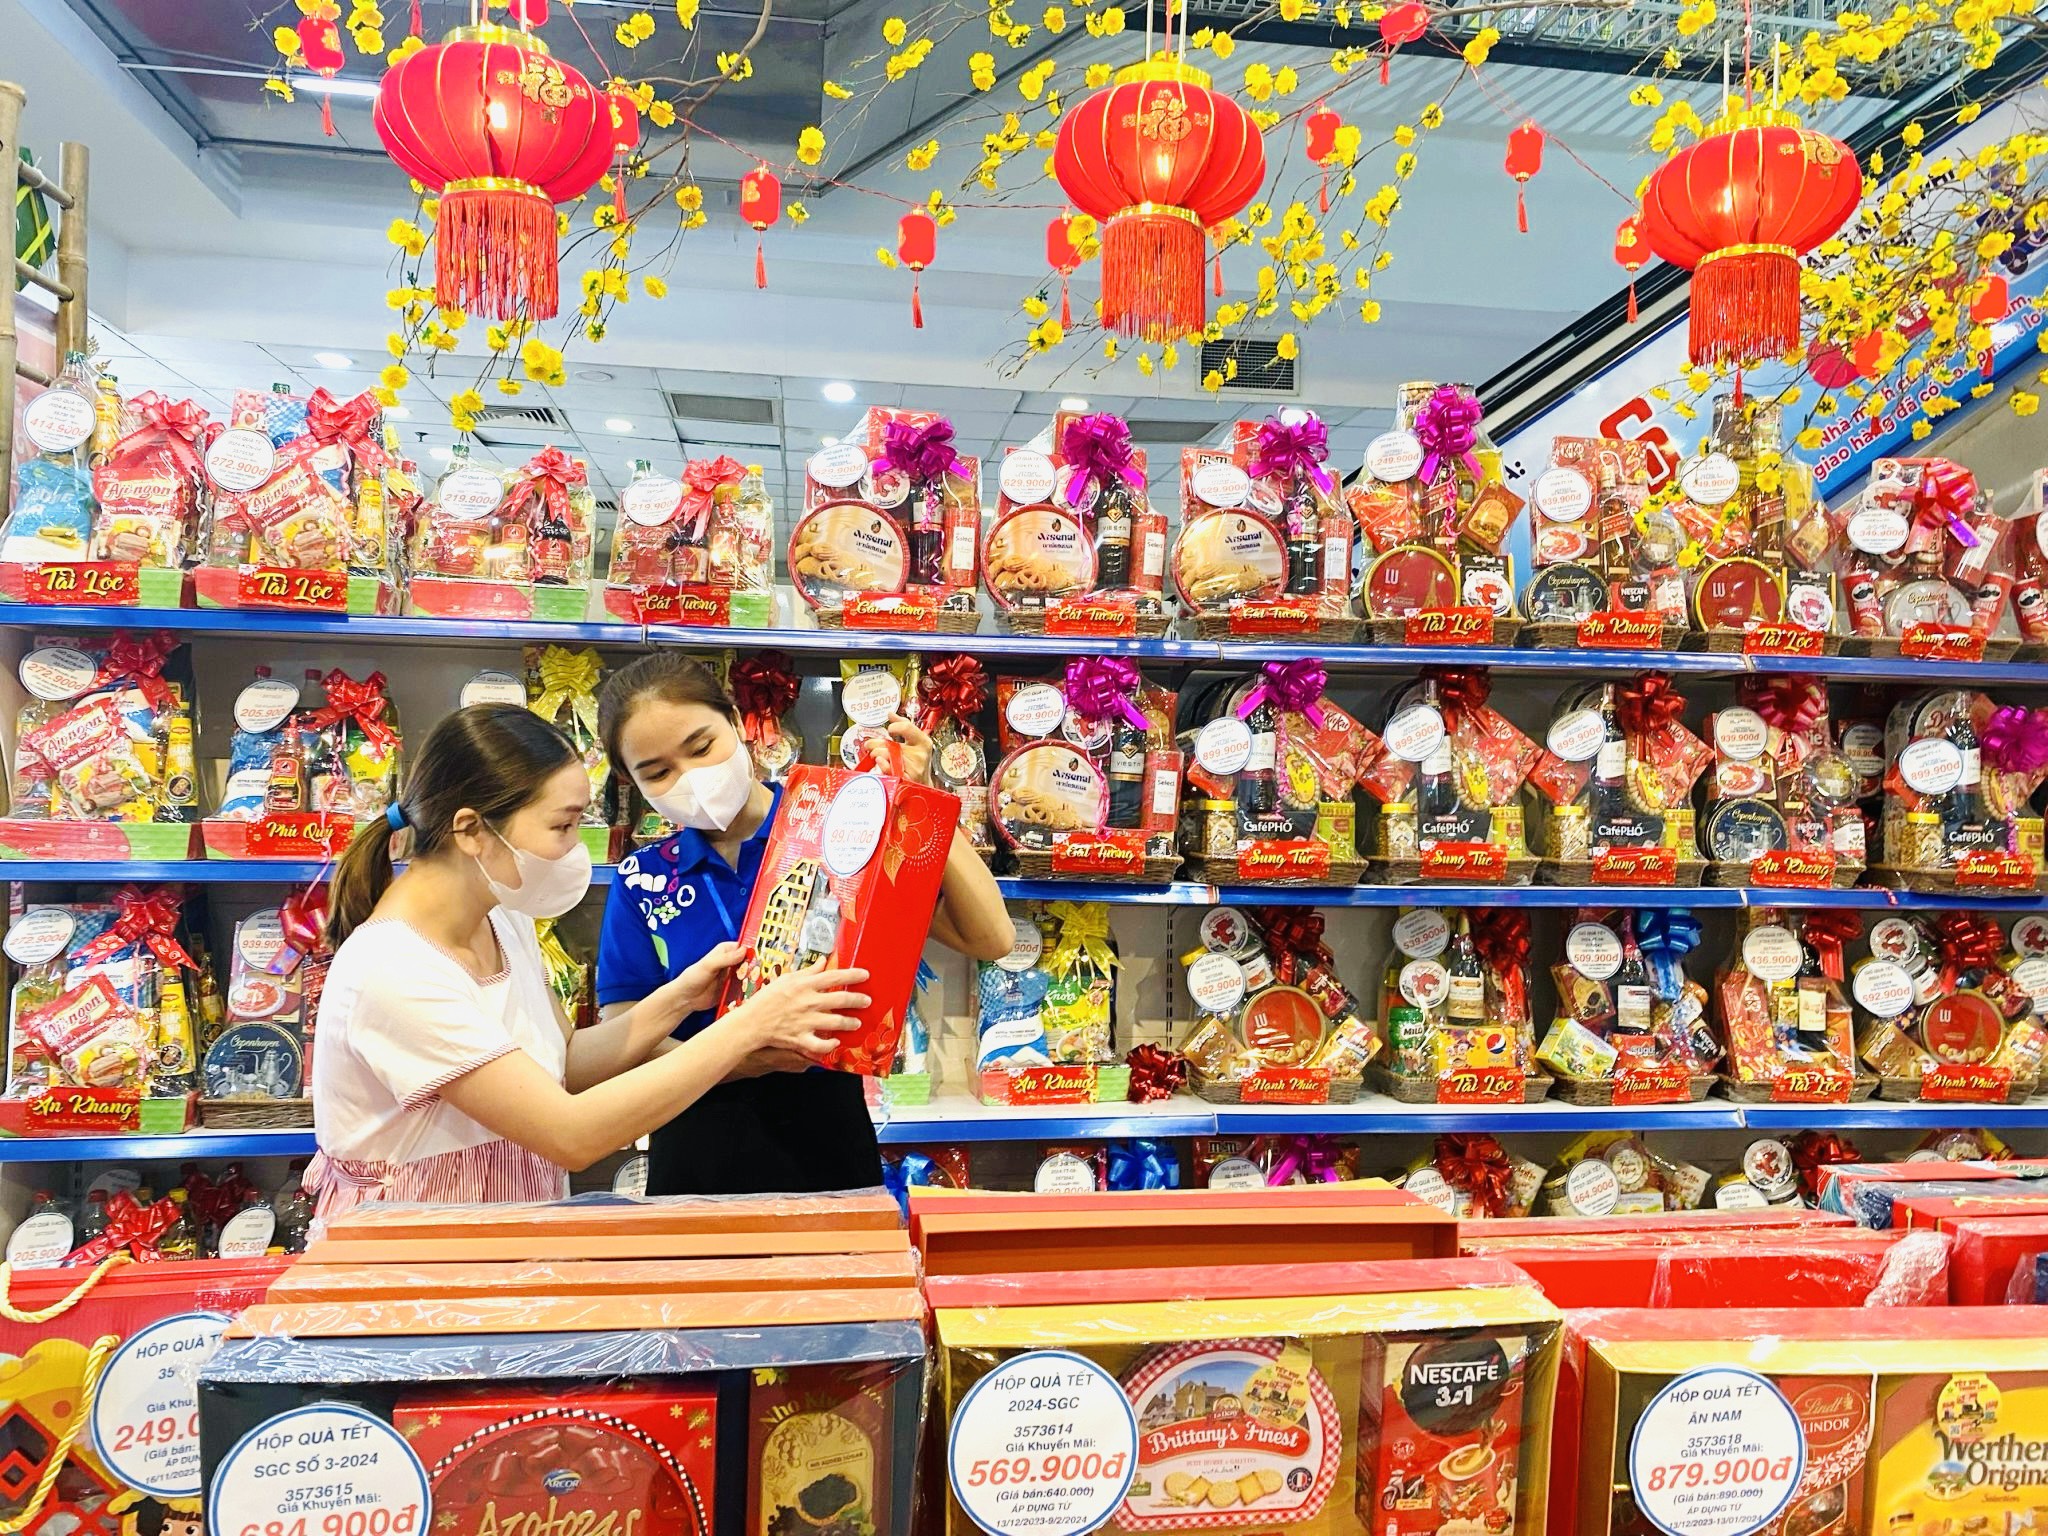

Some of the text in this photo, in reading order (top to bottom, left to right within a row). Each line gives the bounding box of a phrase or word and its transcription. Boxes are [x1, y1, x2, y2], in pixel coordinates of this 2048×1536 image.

[1814, 448, 1849, 481] giao
[1896, 397, 1918, 420] đã
[1919, 381, 1940, 402] có
[211, 456, 268, 477] 272.900đ
[1004, 478, 1051, 488] 629.900đ
[1200, 484, 1246, 494] 629.900đ
[445, 494, 499, 504] 219.900đ
[1542, 494, 1582, 506] 939.900đ
[853, 529, 893, 548] Arsenal
[1037, 532, 1076, 542] Arsenal
[1224, 531, 1263, 545] Arsenal
[39, 567, 77, 592] Tài
[253, 571, 290, 597] Tài
[1385, 569, 1399, 584] LU
[1712, 583, 1726, 598] LU
[646, 593, 719, 616] Cát Tường
[1058, 605, 1081, 621] Cát
[1420, 612, 1446, 632] Tài
[1583, 618, 1657, 640] An Khang
[27, 663, 86, 690] 272.900đ
[850, 693, 898, 713] 539.900đ
[1012, 708, 1061, 721] 629.900đ
[1394, 723, 1440, 751] 899.900đ
[1556, 724, 1603, 751] 899.900đ
[1720, 734, 1760, 742] 939.900đ
[1203, 740, 1249, 760] 899.900đ
[1052, 769, 1091, 784] Arsenal
[1910, 760, 1960, 781] 899.900đ
[1731, 809, 1773, 823] Copenhagen
[266, 821, 335, 843] Phú Quý
[1249, 847, 1315, 868] Sung Túc
[1432, 849, 1493, 870] Sung Túc
[1602, 854, 1664, 875] Sung Túc
[1757, 856, 1831, 880] An Khang
[1967, 858, 1999, 876] Sung
[9, 932, 67, 946] 272.900đ
[241, 939, 283, 949] 939.900
[1403, 926, 1446, 950] 539.900đ
[1574, 953, 1619, 962] 509.900đ
[1751, 955, 1798, 965] 436.900đ
[1196, 976, 1242, 997] 592.900đ
[1862, 987, 1910, 1003] 592.900đ
[1044, 990, 1078, 1003] Knorr
[1254, 1012, 1268, 1029] LU
[1939, 1009, 1951, 1023] LU
[1403, 1027, 1423, 1036] MILO
[230, 1034, 281, 1052] Copenhagen
[1014, 1073, 1093, 1095] An Khang
[1252, 1077, 1319, 1091] Hạnh Phúc
[1451, 1074, 1478, 1093] Tài
[1621, 1078, 1652, 1093] Hạnh
[1933, 1073, 1967, 1089] Hạnh
[31, 1094, 133, 1120] An Khang
[1573, 1178, 1614, 1204] 464.900đ
[173, 1334, 205, 1352] QUÀ
[1410, 1355, 1498, 1385] NESCAFÉ
[994, 1369, 1095, 1394] HỘP QUÀ TẾT
[1670, 1381, 1762, 1405] HỘP QUÀ TẾT
[146, 1401, 166, 1413] Giá
[1008, 1397, 1080, 1412] 2024-SGC
[1801, 1395, 1843, 1415] Lindt
[1709, 1410, 1742, 1423] NAM
[1803, 1417, 1850, 1434] LINDOR
[257, 1424, 374, 1453] HỘP QUÀ TẾT
[1013, 1423, 1074, 1438] 3573614
[1147, 1418, 1299, 1455] Brittany's Finest
[1005, 1437, 1097, 1453] Giá Khuyến Mãi:
[1687, 1433, 1742, 1448] 3573618
[143, 1444, 196, 1462] (Giá bán:
[1680, 1443, 1764, 1460] Giá Khuyến Mãi:
[253, 1452, 379, 1479] SGC SỐ 3-2024
[967, 1452, 1128, 1487] 569.900đ
[1647, 1456, 1793, 1492] 879.900đ
[542, 1477, 580, 1489] ARCOR
[285, 1483, 353, 1502] 3573615
[996, 1486, 1095, 1502] (Giá bán:640.000)
[1673, 1488, 1764, 1505] (Giá bán:890.000)
[276, 1494, 382, 1514] Giá Khuyến Mãi:
[1011, 1502, 1027, 1514] ÁP
[1028, 1501, 1056, 1515] DỤNG
[1687, 1503, 1700, 1516] ÁP
[1701, 1503, 1728, 1516] DỤNG
[238, 1503, 419, 1536] 684.900đ
[996, 1515, 1087, 1529] 13/12/2023-9/2/2024
[1668, 1514, 1763, 1530] 13/12/2023-13/01/2024
